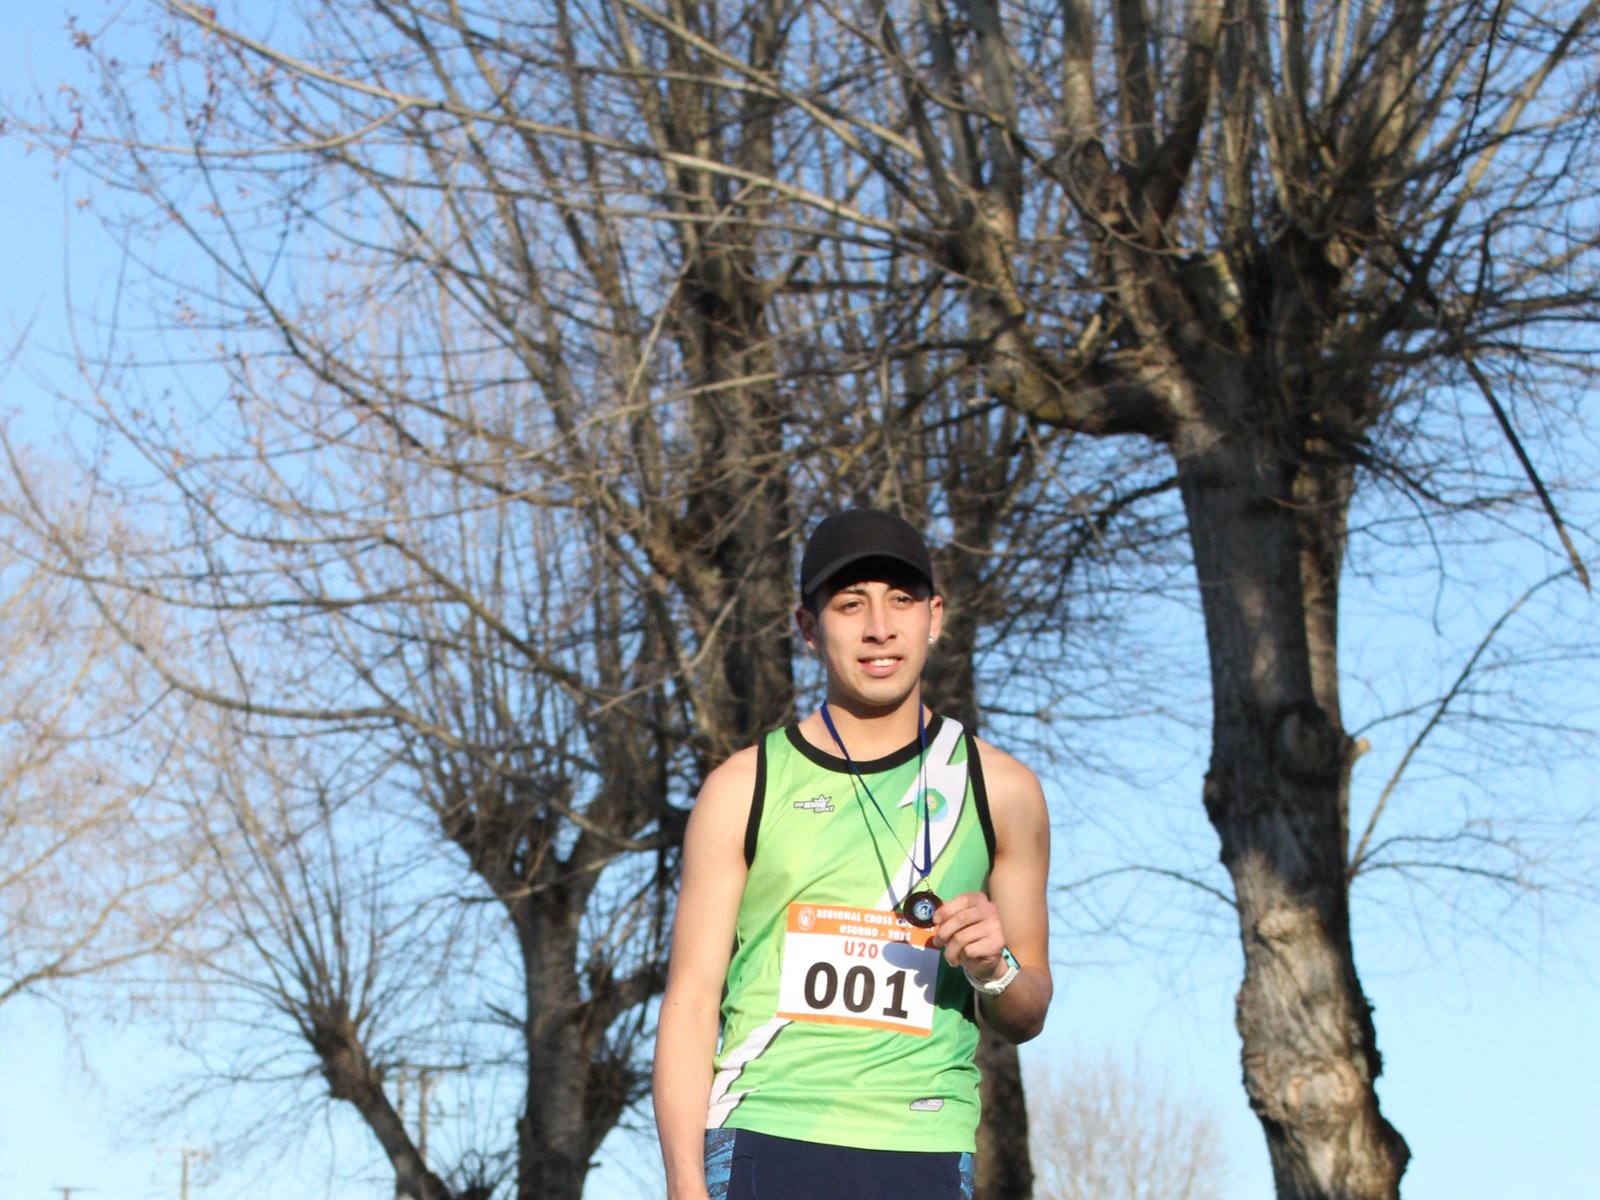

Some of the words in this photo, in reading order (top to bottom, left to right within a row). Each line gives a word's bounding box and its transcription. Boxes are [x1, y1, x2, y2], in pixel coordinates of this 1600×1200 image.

[816, 909, 861, 921] REGIONAL
[864, 914, 893, 925] CROSS
[840, 924, 878, 937] OSORNO
[844, 941, 878, 958] U20
[804, 961, 908, 1019] 001
